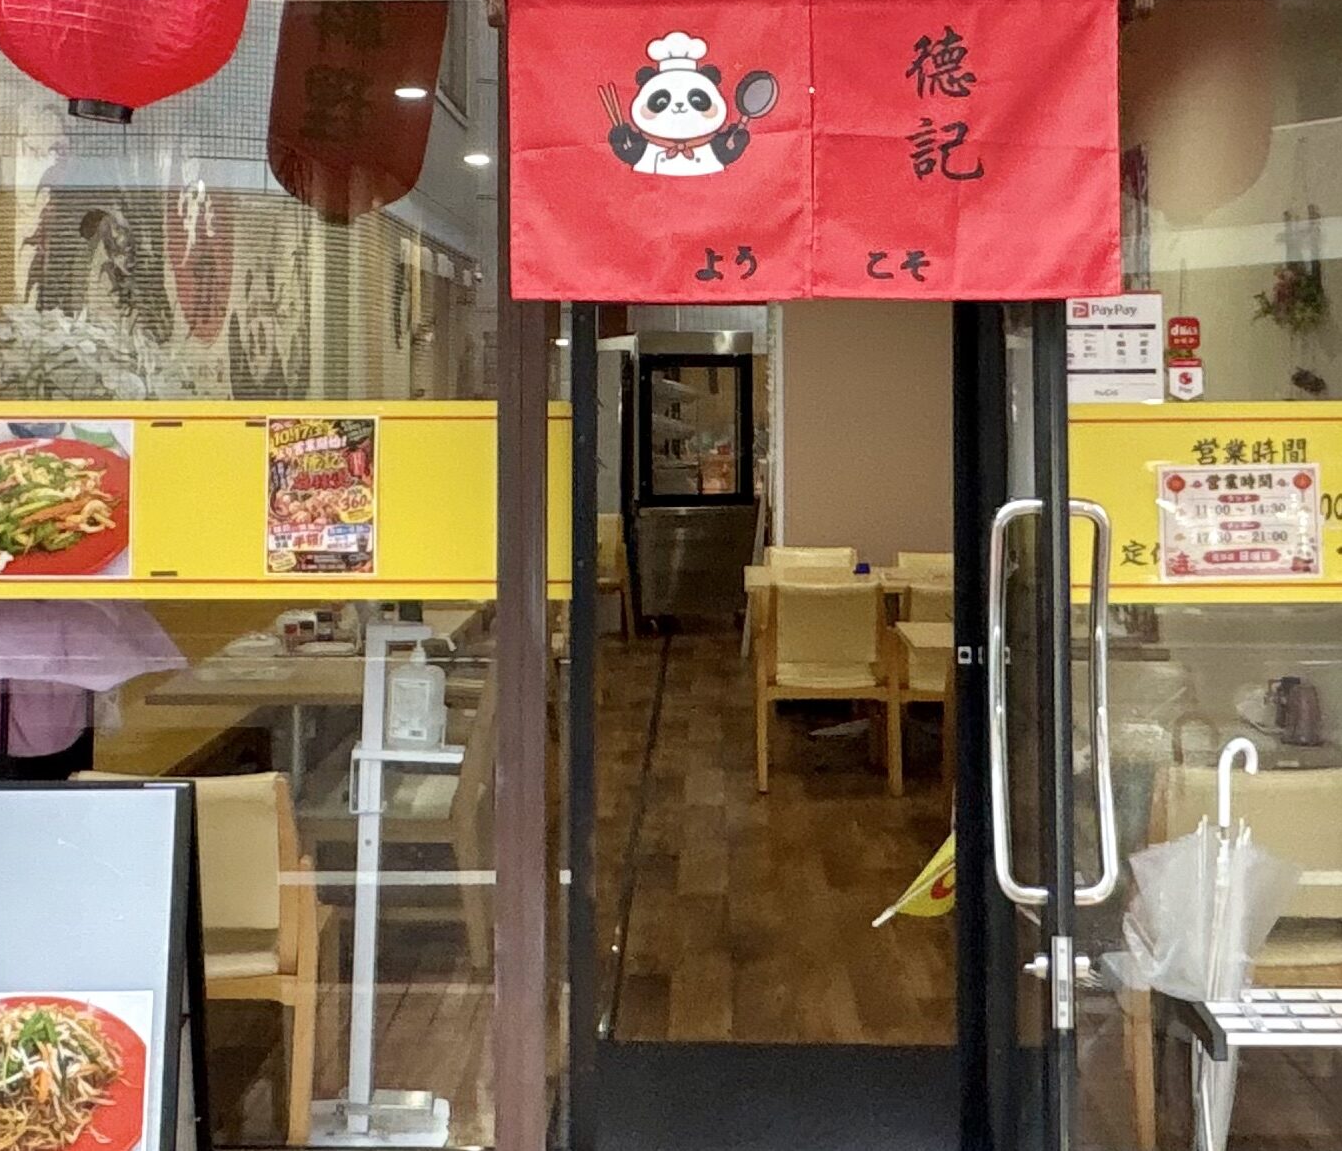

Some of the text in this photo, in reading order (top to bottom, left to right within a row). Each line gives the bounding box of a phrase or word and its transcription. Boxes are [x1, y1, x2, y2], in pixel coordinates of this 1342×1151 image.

[694, 245, 931, 282] よう こそ
[1091, 304, 1138, 318] PayPay
[1191, 437, 1308, 465] 営業時間
[1205, 472, 1273, 491] 営業時間
[1252, 530, 1289, 542] 21:00
